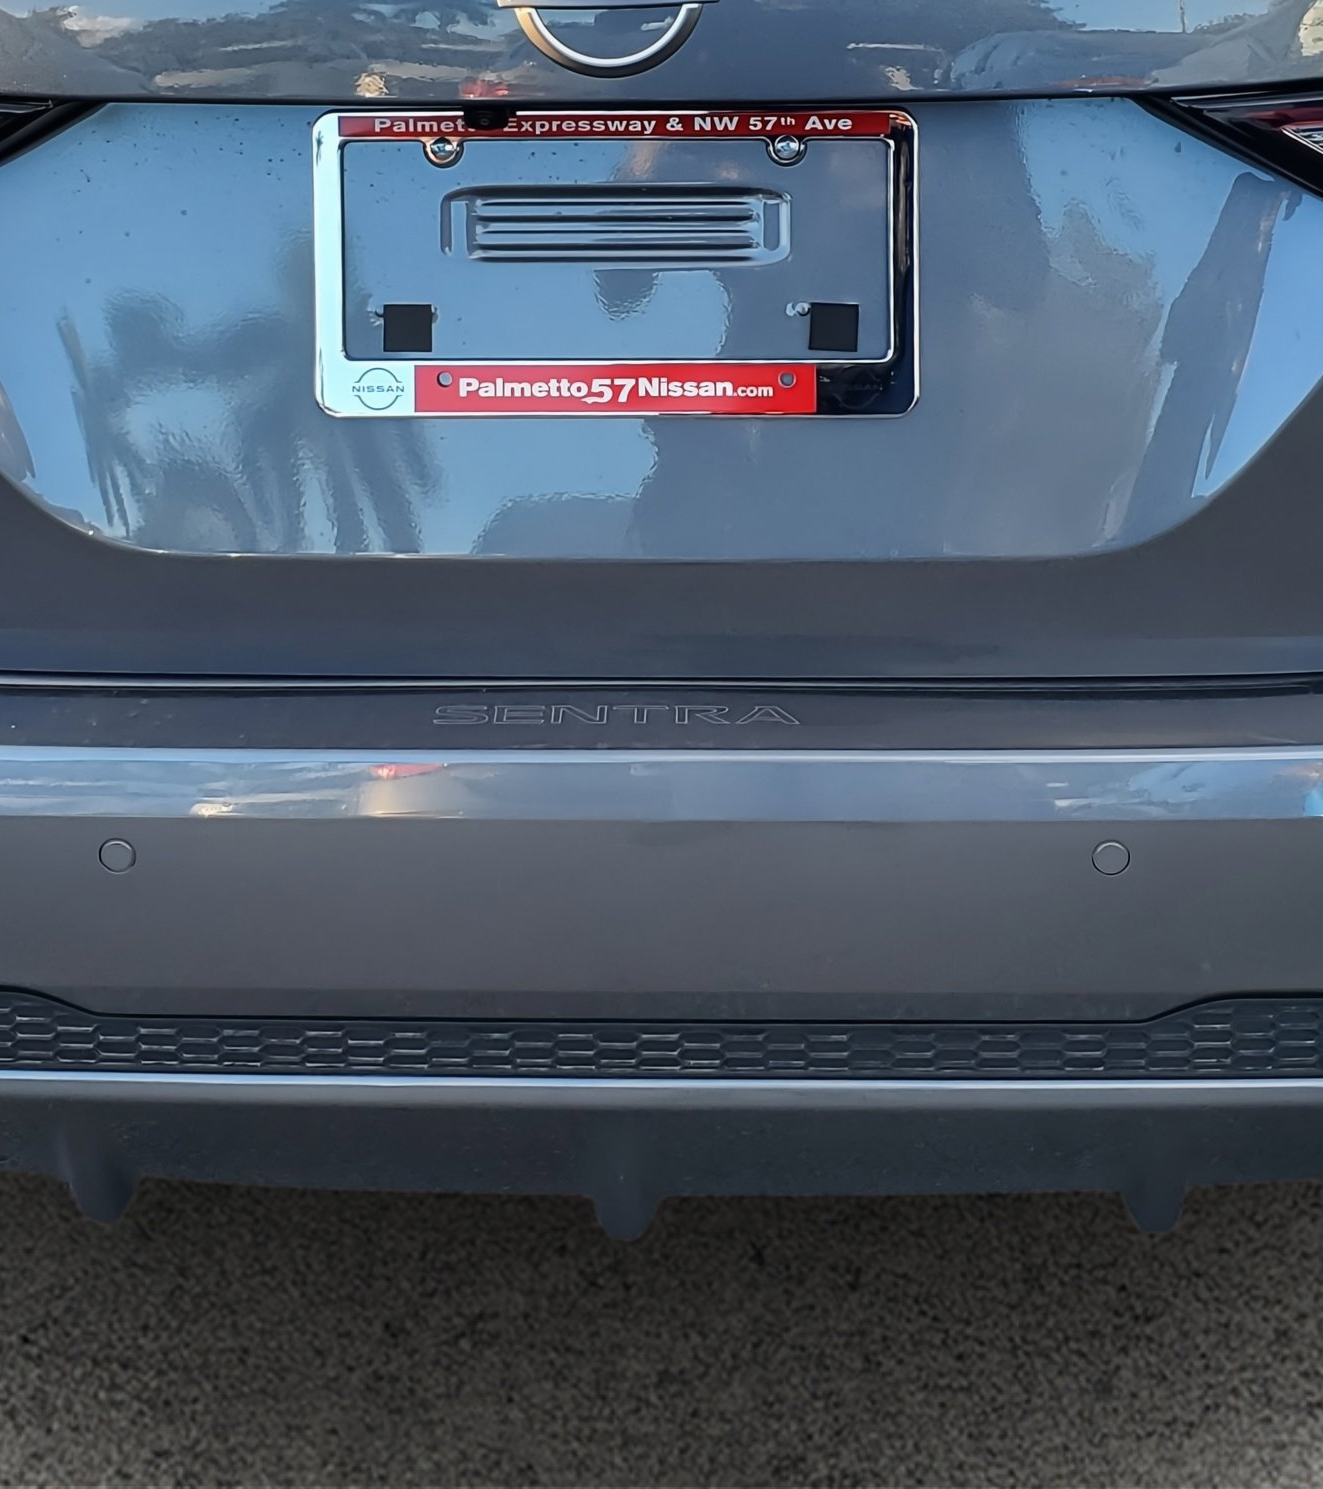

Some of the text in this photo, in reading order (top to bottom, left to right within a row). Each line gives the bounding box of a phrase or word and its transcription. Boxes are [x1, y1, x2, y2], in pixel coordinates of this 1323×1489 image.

[373, 115, 854, 135] Palmet Expressway & NW 57th Ave
[351, 384, 406, 394] NISSAN
[432, 704, 801, 726] SENTRA
